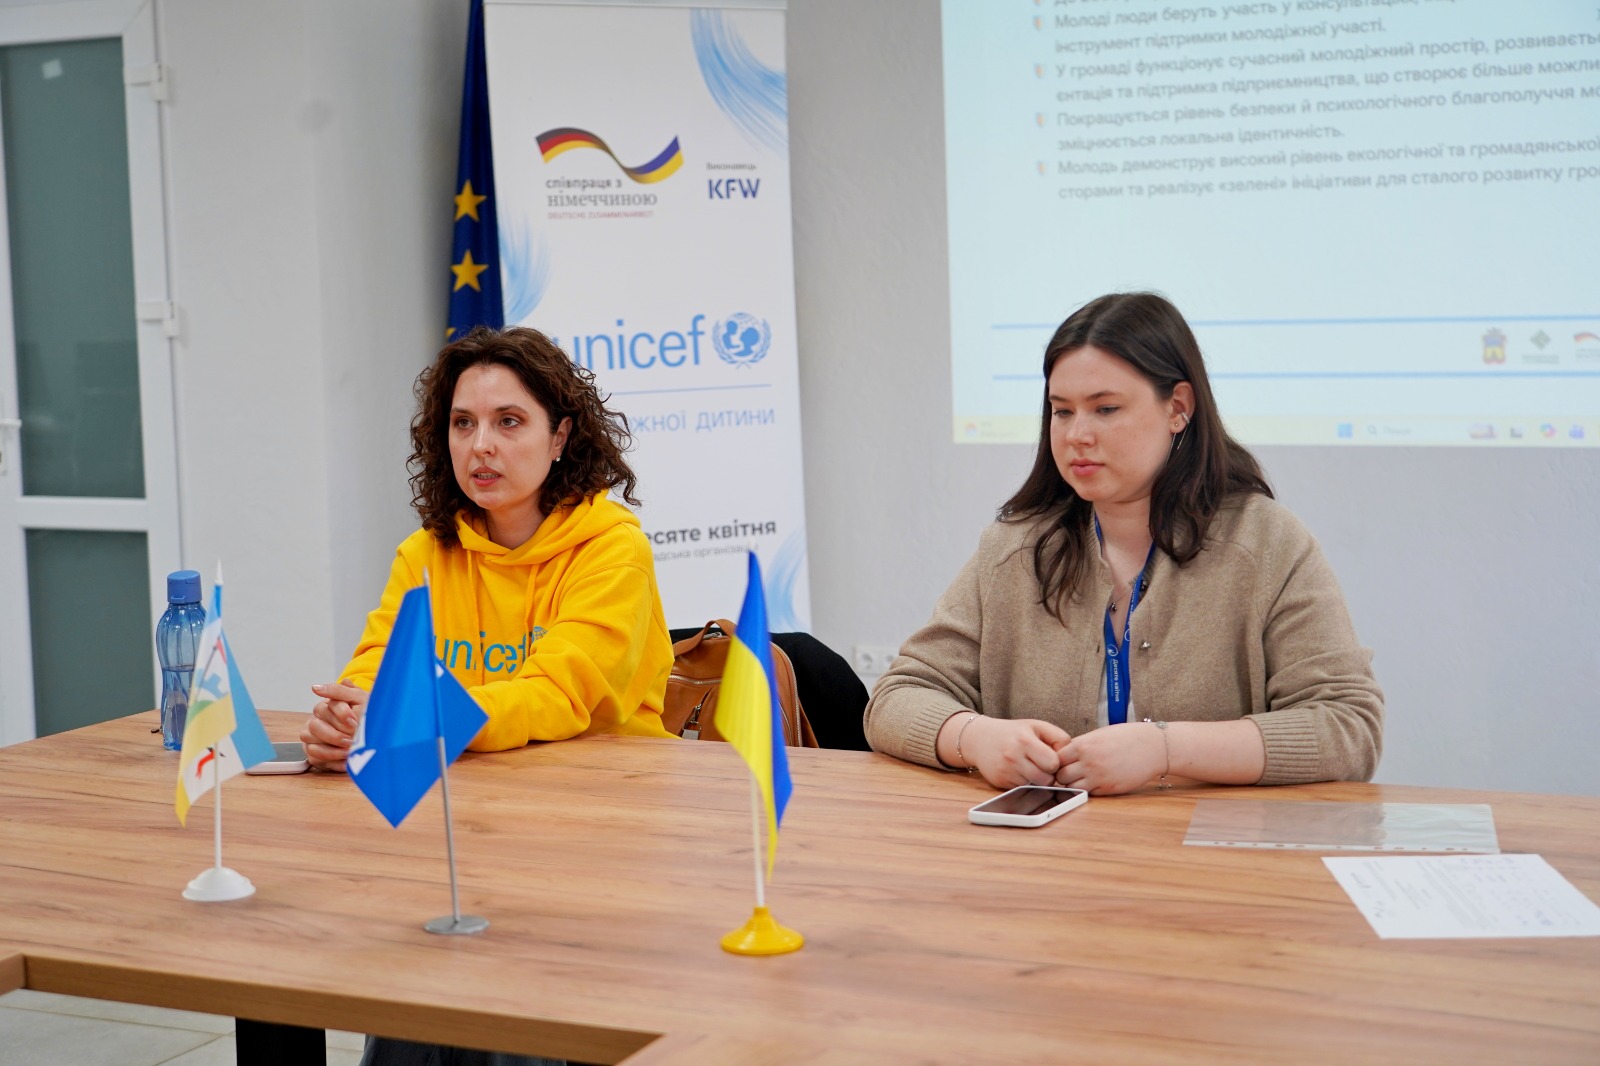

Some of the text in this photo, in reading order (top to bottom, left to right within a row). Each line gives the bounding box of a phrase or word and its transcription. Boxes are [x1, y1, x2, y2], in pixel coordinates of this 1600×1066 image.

[1054, 11, 1111, 28] Молоді
[1115, 11, 1158, 26] люди
[1162, 6, 1217, 23] беруть
[1222, 3, 1277, 20] участь
[1282, 0, 1291, 16] у
[1055, 17, 1386, 54] інструмент підтримки молодіжної участі.
[1056, 64, 1067, 78] У
[1070, 59, 1131, 79] громаді
[1136, 55, 1225, 76] функціонує
[1229, 48, 1306, 70] сучасний
[1310, 41, 1414, 62] молодіжний
[1420, 37, 1489, 57] простір,
[1057, 85, 1113, 102] єнтація
[1117, 86, 1133, 99] та
[1137, 79, 1218, 99] підтримка
[1222, 71, 1360, 94] підприємництва,
[1364, 71, 1389, 86] що
[1393, 65, 1467, 84] створює
[1472, 60, 1533, 77] більше
[1057, 106, 1169, 127] Покращується
[1174, 104, 1225, 123] рівень
[1230, 102, 1296, 117] безпеки
[1301, 98, 1312, 113] й
[1317, 93, 1446, 114] психологічного
[1451, 86, 1574, 108] благополуччя
[1057, 123, 1345, 152] зміцнюється локальна ідентичність.
[1058, 159, 1118, 176] Молодь
[1122, 153, 1216, 174] демонструє
[1220, 150, 1286, 167] високий
[1291, 148, 1343, 168] рівень
[1347, 142, 1444, 162] екологічної
[1448, 145, 1466, 157] та
[545, 176, 612, 191] співпраця
[708, 178, 760, 199] KFW
[1058, 183, 1123, 200] сторами
[1127, 184, 1144, 197] та
[1148, 178, 1214, 198] реалізує
[1291, 172, 1371, 191] ініціативи
[1376, 172, 1407, 188] для
[1411, 168, 1478, 185] сталого
[1483, 165, 1563, 186] розвитку
[1568, 164, 1600, 182] гро
[546, 190, 658, 207] німеччиною
[628, 409, 688, 433] жної
[644, 518, 777, 547] сяте квітня
